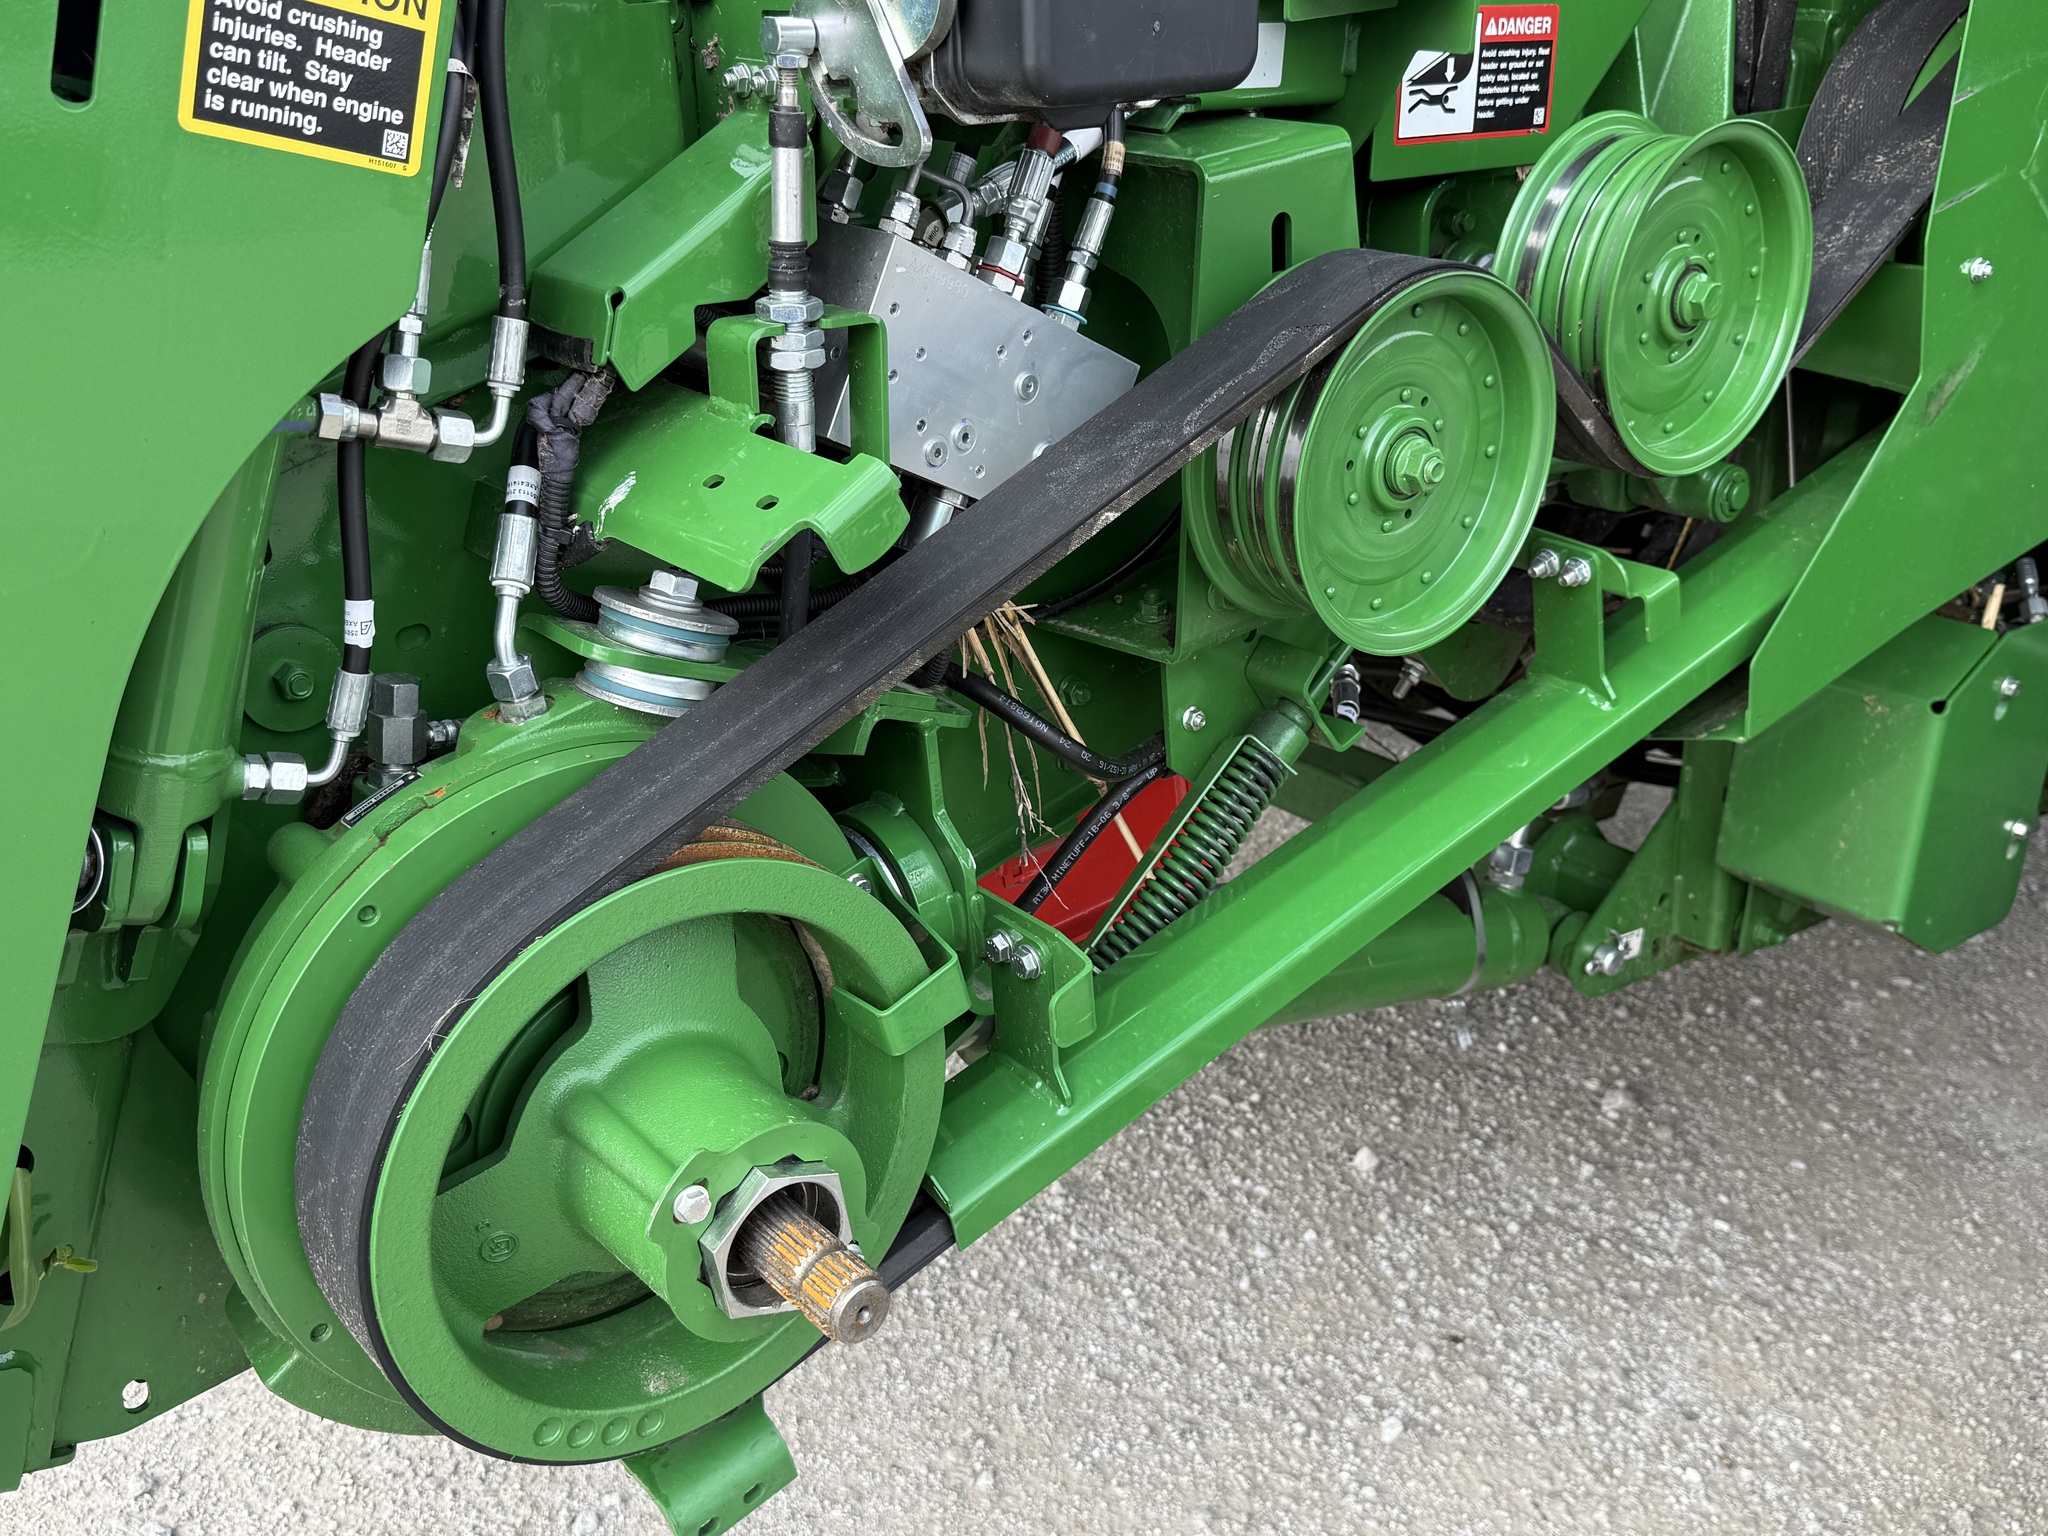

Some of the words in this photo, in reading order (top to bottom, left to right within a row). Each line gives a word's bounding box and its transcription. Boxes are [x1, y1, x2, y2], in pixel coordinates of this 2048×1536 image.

[288, 7, 383, 49] crushing
[1498, 18, 1552, 35] DANGER
[212, 11, 303, 51] injuries.
[315, 36, 392, 72] Header
[1482, 48, 1497, 58] Avoid
[1498, 48, 1520, 58] crushing
[209, 42, 251, 65] can
[257, 51, 292, 75] tilt.
[304, 60, 354, 92] Stay
[1481, 61, 1498, 70] header
[1500, 62, 1507, 70] on
[1508, 59, 1527, 71] ground
[1480, 73, 1495, 84] safety
[1511, 72, 1530, 81] located
[1531, 72, 1539, 80] on
[206, 66, 264, 94] clear
[269, 81, 327, 109] when
[333, 96, 404, 125] engine
[1479, 85, 1510, 95] feederhouse
[1478, 98, 1494, 107] before
[1495, 96, 1514, 108] getting
[1515, 97, 1530, 105] under
[204, 88, 225, 111] is
[230, 97, 323, 136] running.
[1477, 109, 1496, 119] header.
[368, 158, 397, 170] H151607
[907, 257, 970, 298] AXE49980
[1059, 736, 1073, 749] 24
[353, 799, 373, 815] JOHN
[374, 783, 398, 801] DEERE
[1051, 811, 1112, 882] MINETUFF-1B-06
